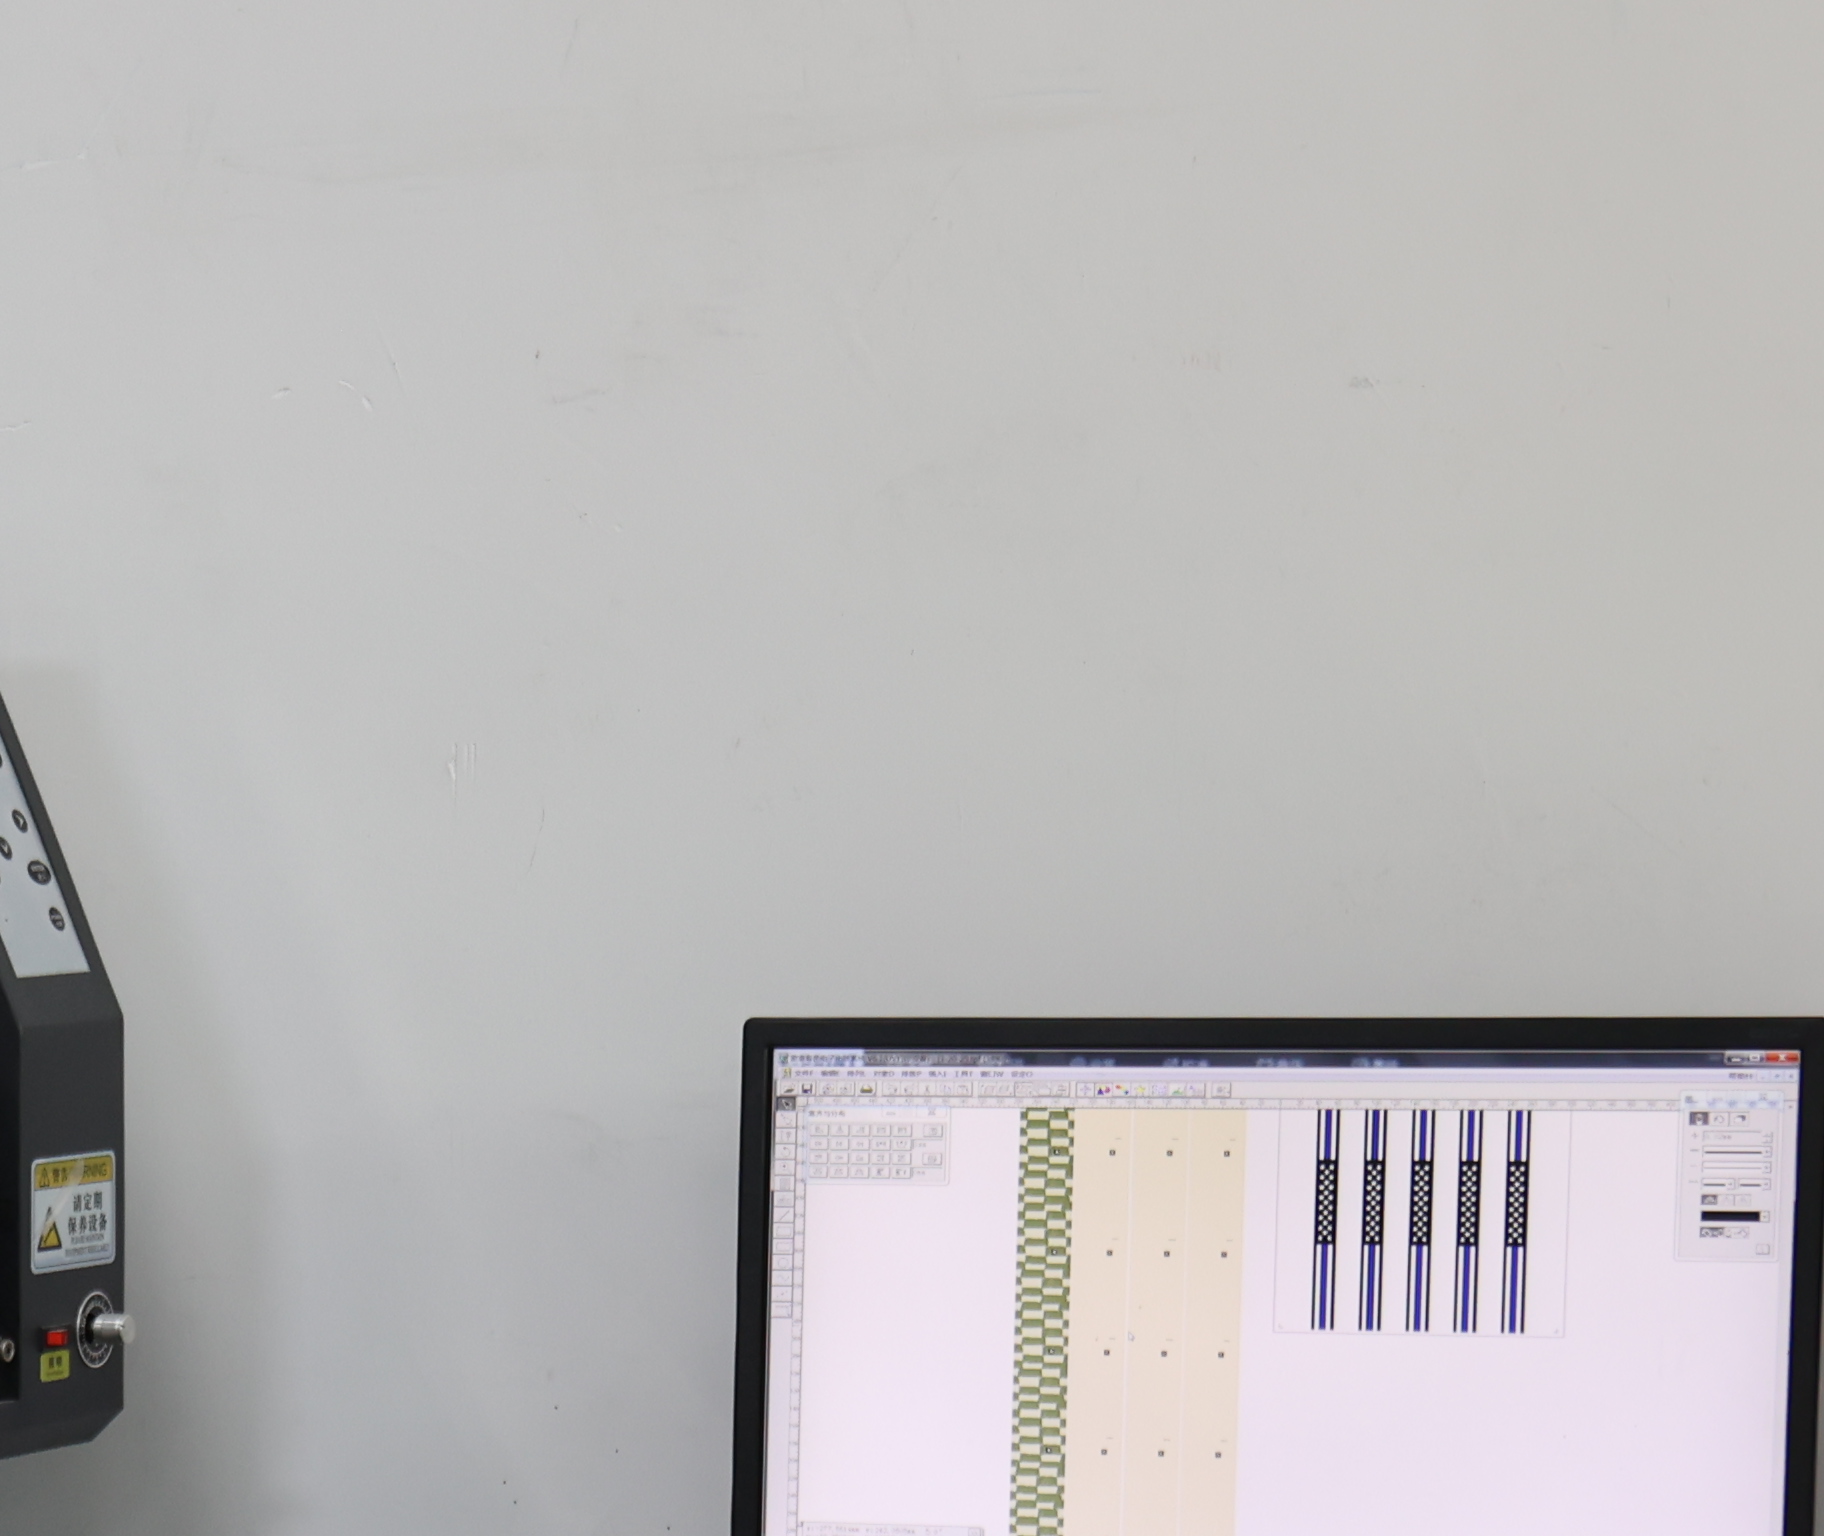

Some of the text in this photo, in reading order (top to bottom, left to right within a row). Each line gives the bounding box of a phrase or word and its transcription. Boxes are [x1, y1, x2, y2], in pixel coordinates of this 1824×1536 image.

[73, 1191, 103, 1213] 请定期
[68, 1213, 108, 1236] 保养设备
